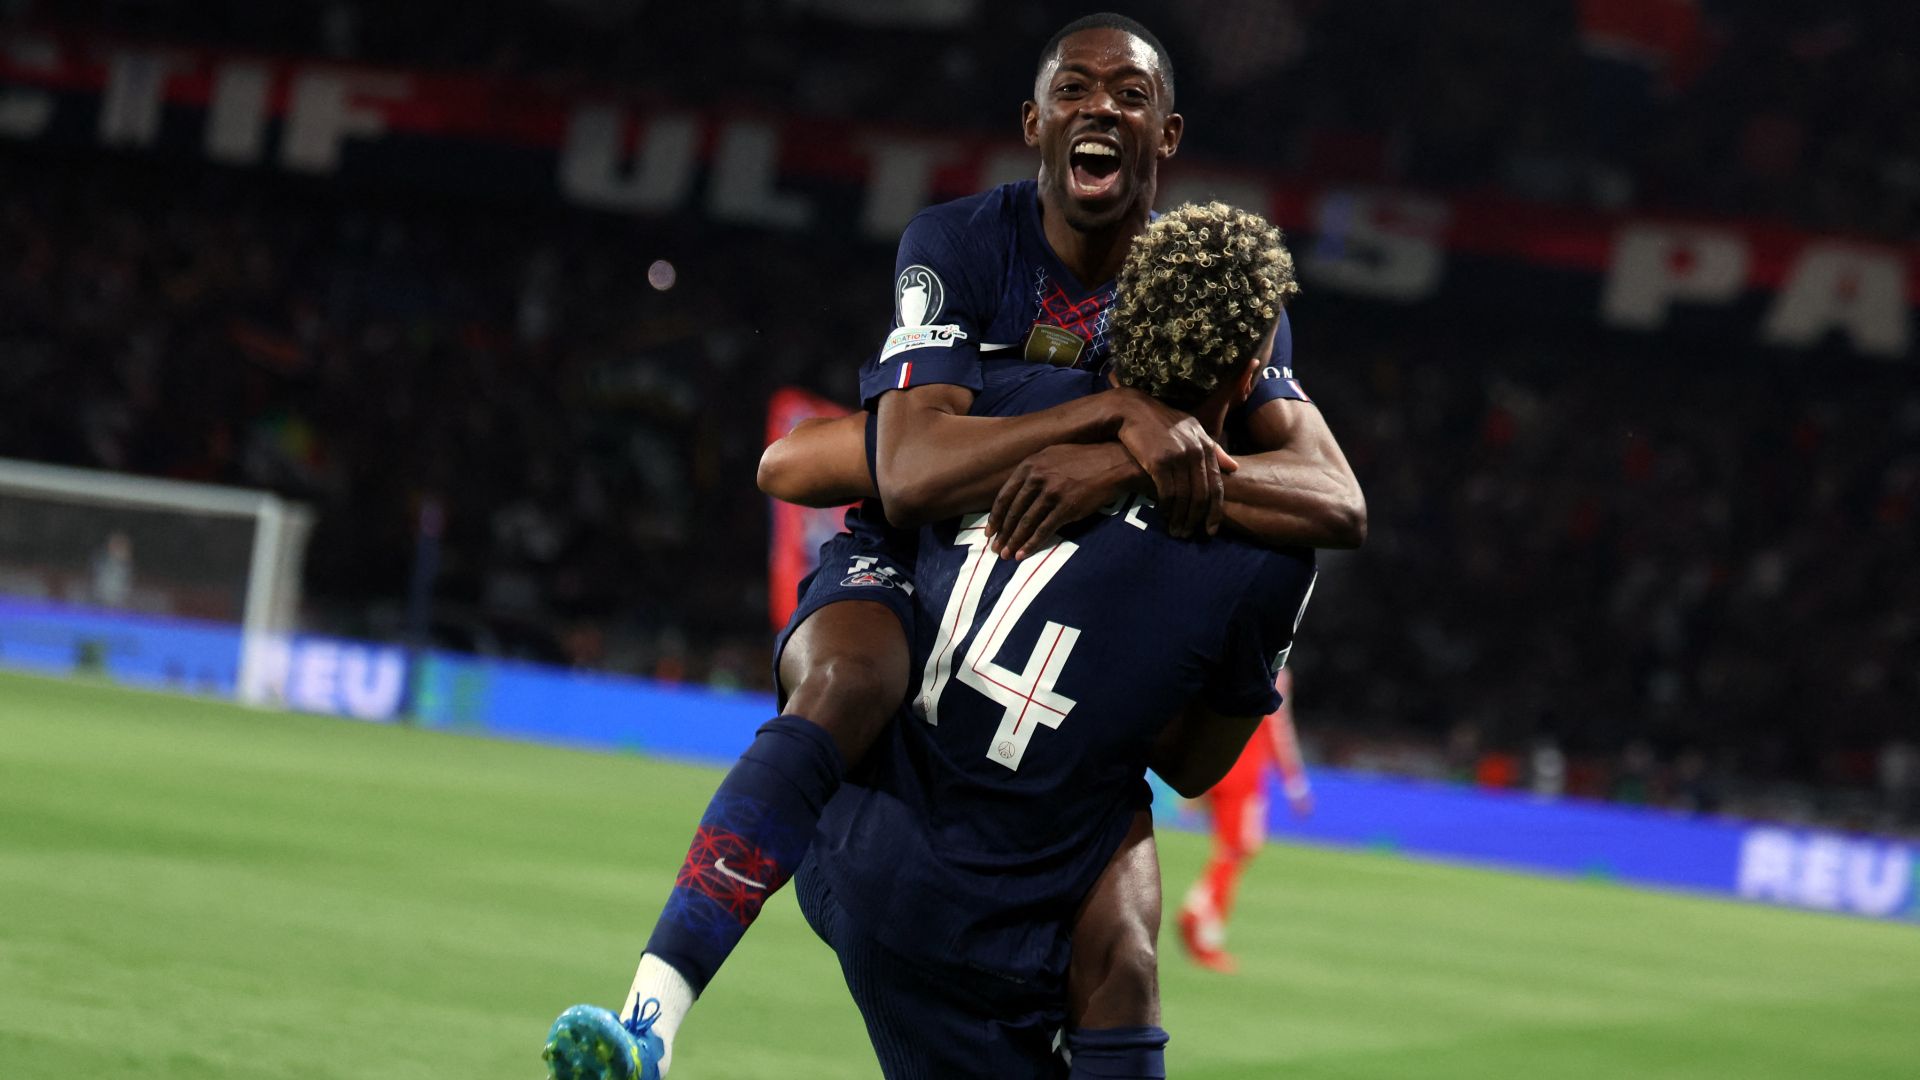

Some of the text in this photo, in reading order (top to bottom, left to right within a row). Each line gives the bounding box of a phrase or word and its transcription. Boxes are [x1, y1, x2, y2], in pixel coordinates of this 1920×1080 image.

[556, 98, 1448, 300] ULTS
[1600, 218, 1914, 358] PA
[912, 512, 1081, 772] 14
